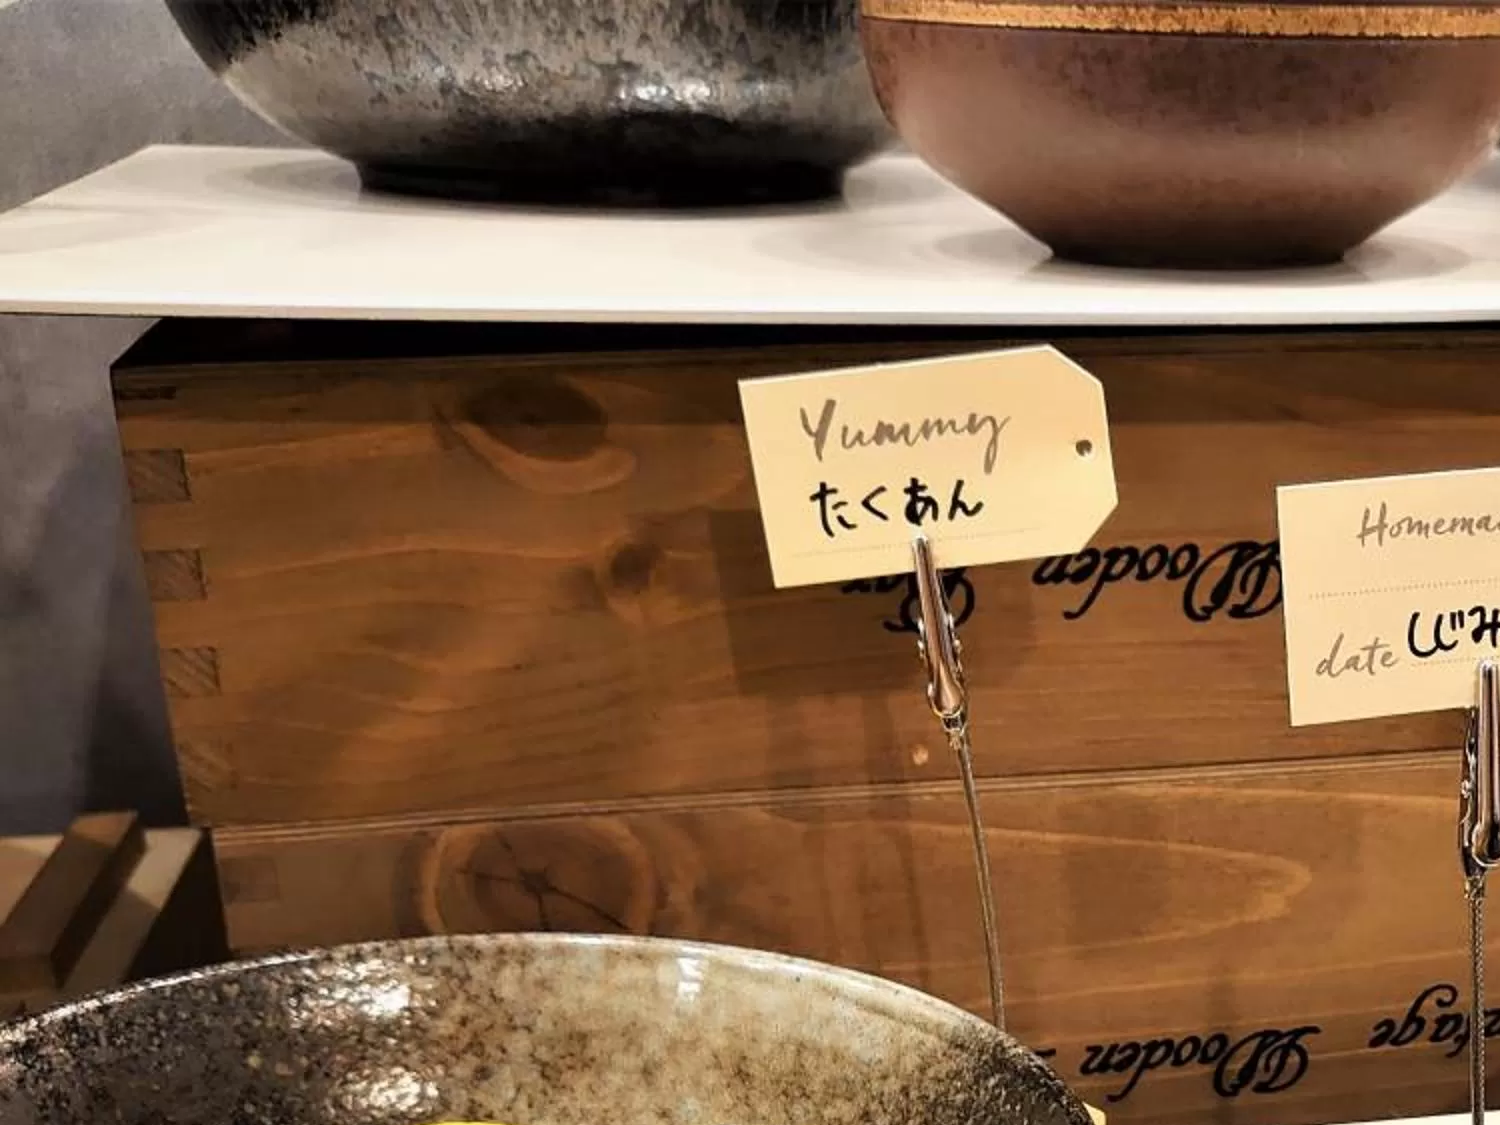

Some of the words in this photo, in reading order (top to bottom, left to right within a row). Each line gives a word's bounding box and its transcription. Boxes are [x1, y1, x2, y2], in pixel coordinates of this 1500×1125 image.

[800, 399, 1011, 475] Yummy
[810, 477, 984, 538] たくあん
[1032, 540, 1284, 621] Wooden
[1315, 633, 1399, 679] date
[1080, 1026, 1320, 1101] Wooden
